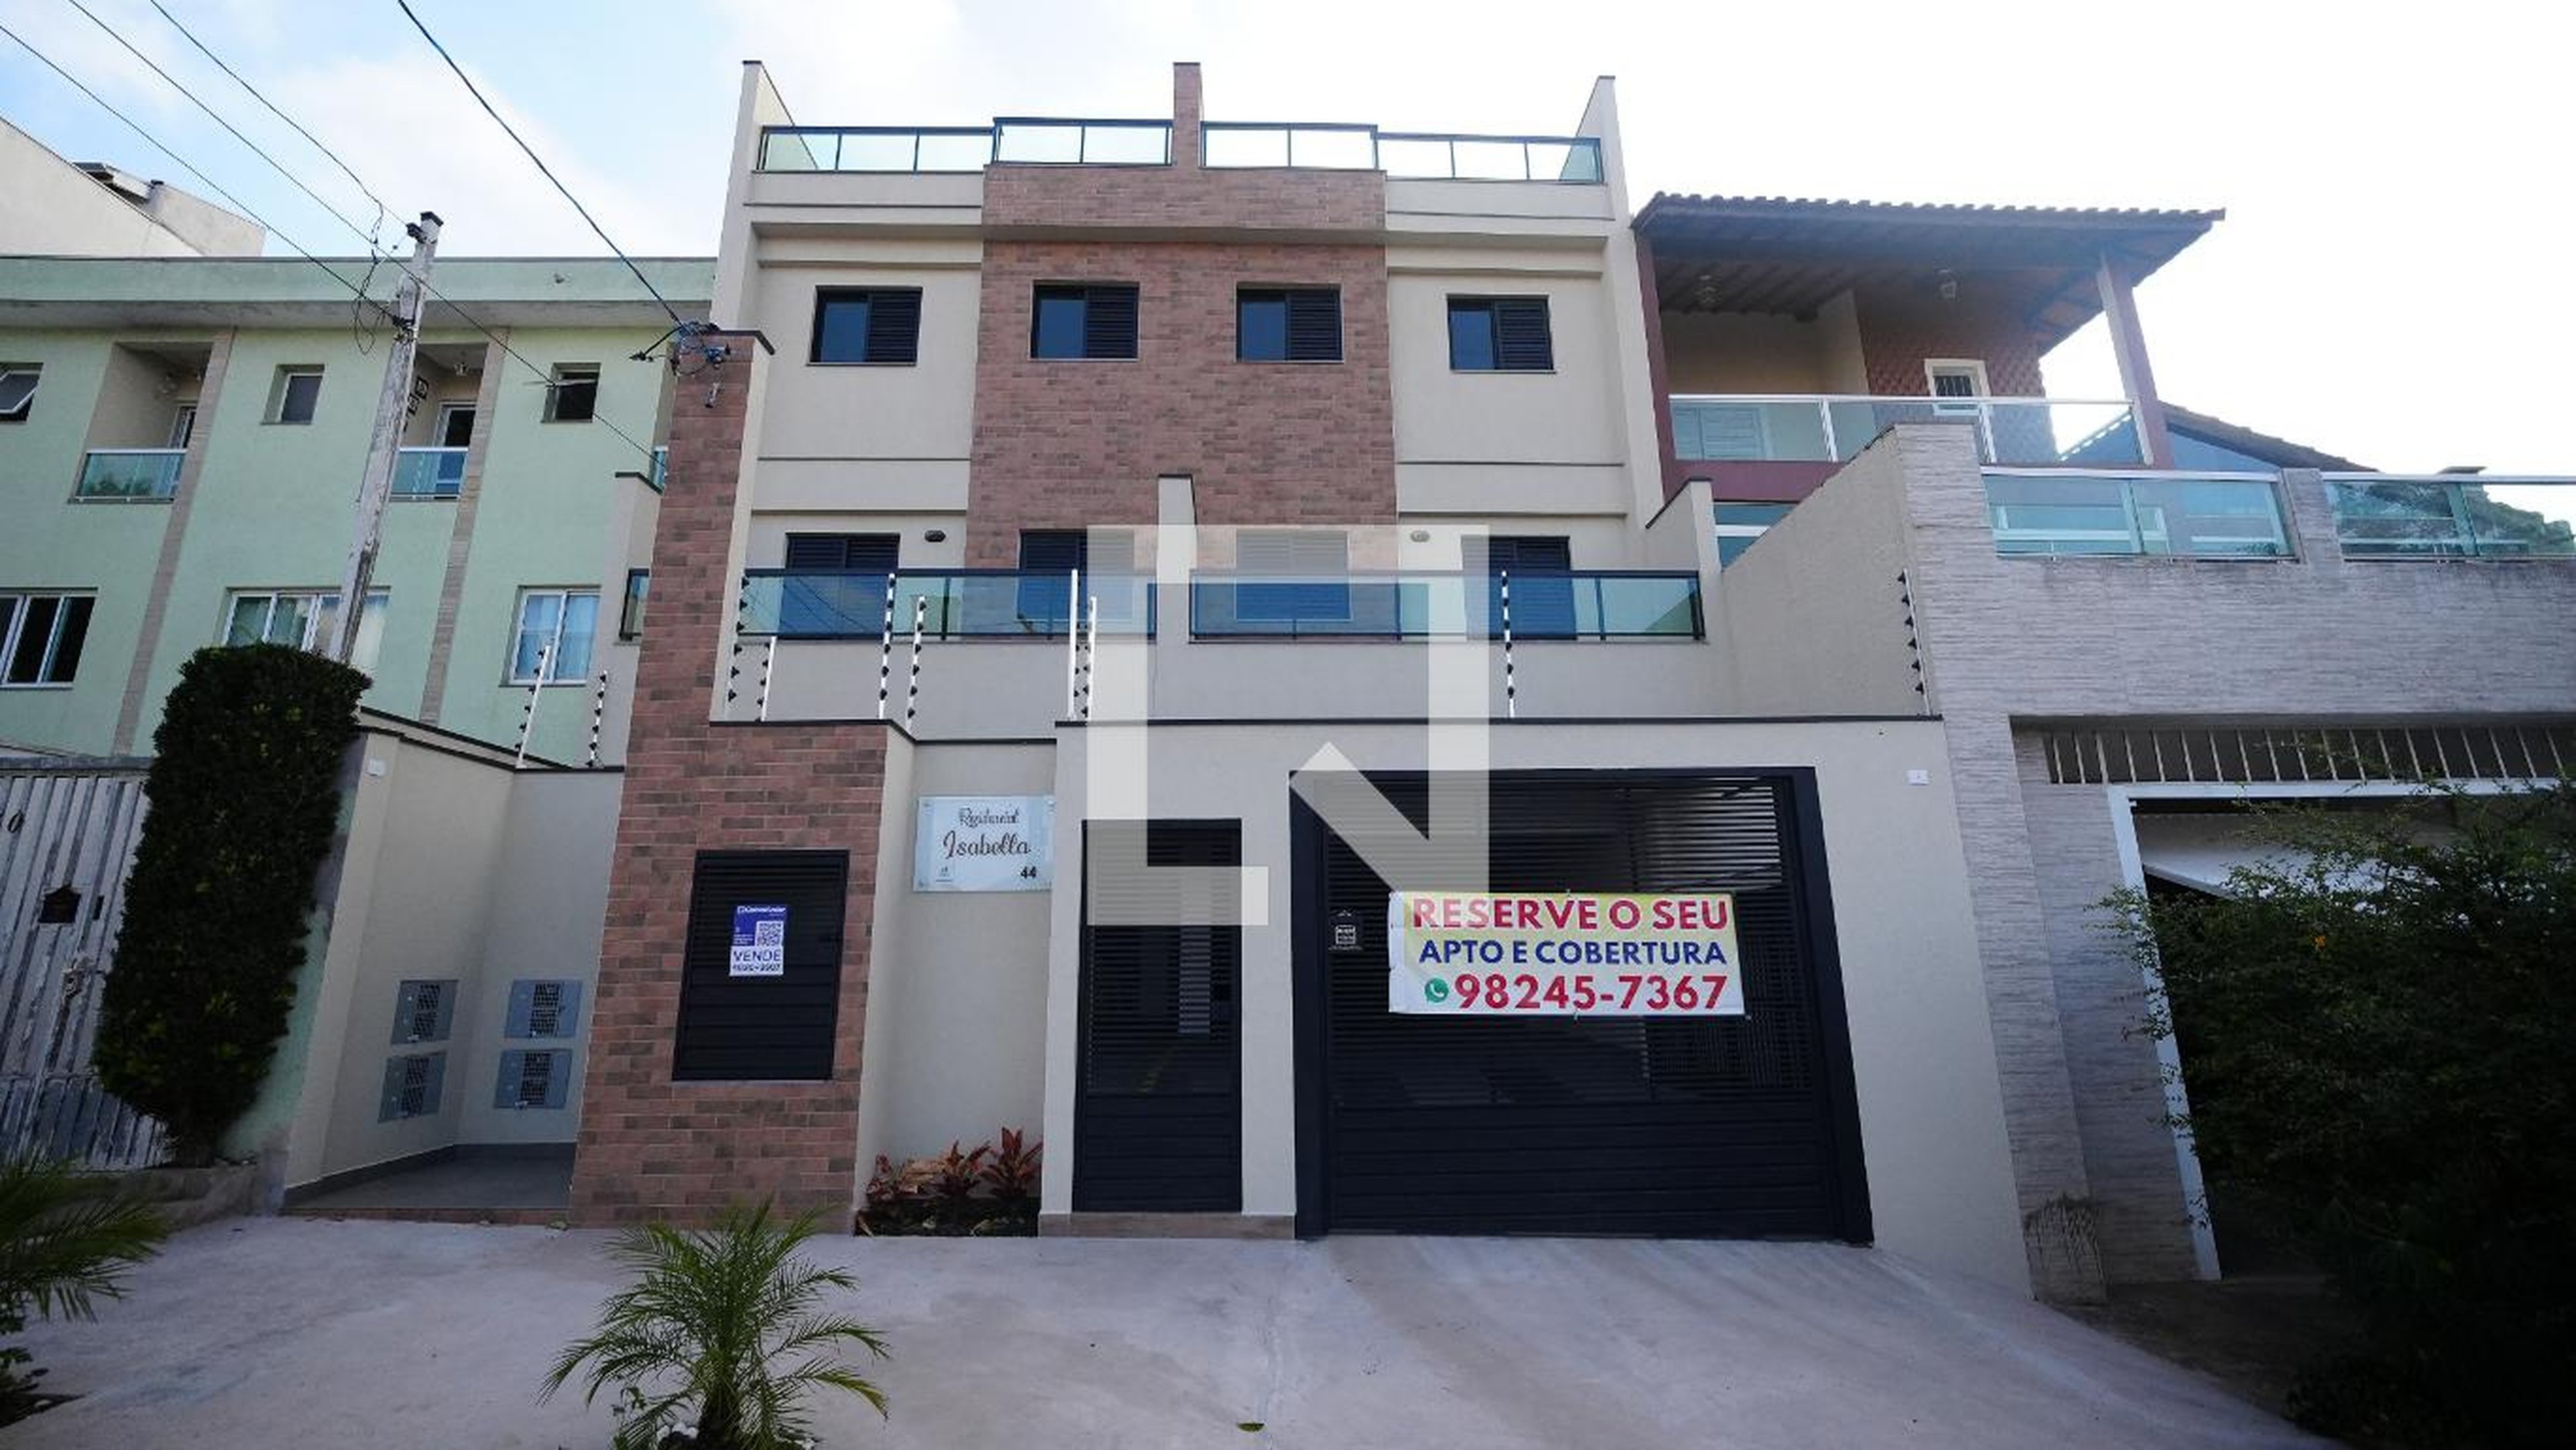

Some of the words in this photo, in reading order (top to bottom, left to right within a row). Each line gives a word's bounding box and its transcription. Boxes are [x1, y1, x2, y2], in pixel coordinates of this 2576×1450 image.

[943, 830, 1032, 859] Isabella
[1413, 899, 1597, 929] RESERVE
[1609, 900, 1641, 929] O
[1653, 900, 1728, 929] SEU
[733, 950, 780, 962] VENDE
[1419, 940, 1504, 964] APTO
[1513, 941, 1527, 964] E
[1535, 940, 1727, 965] COBERTURA
[1454, 974, 1728, 1009] 98245-7367
